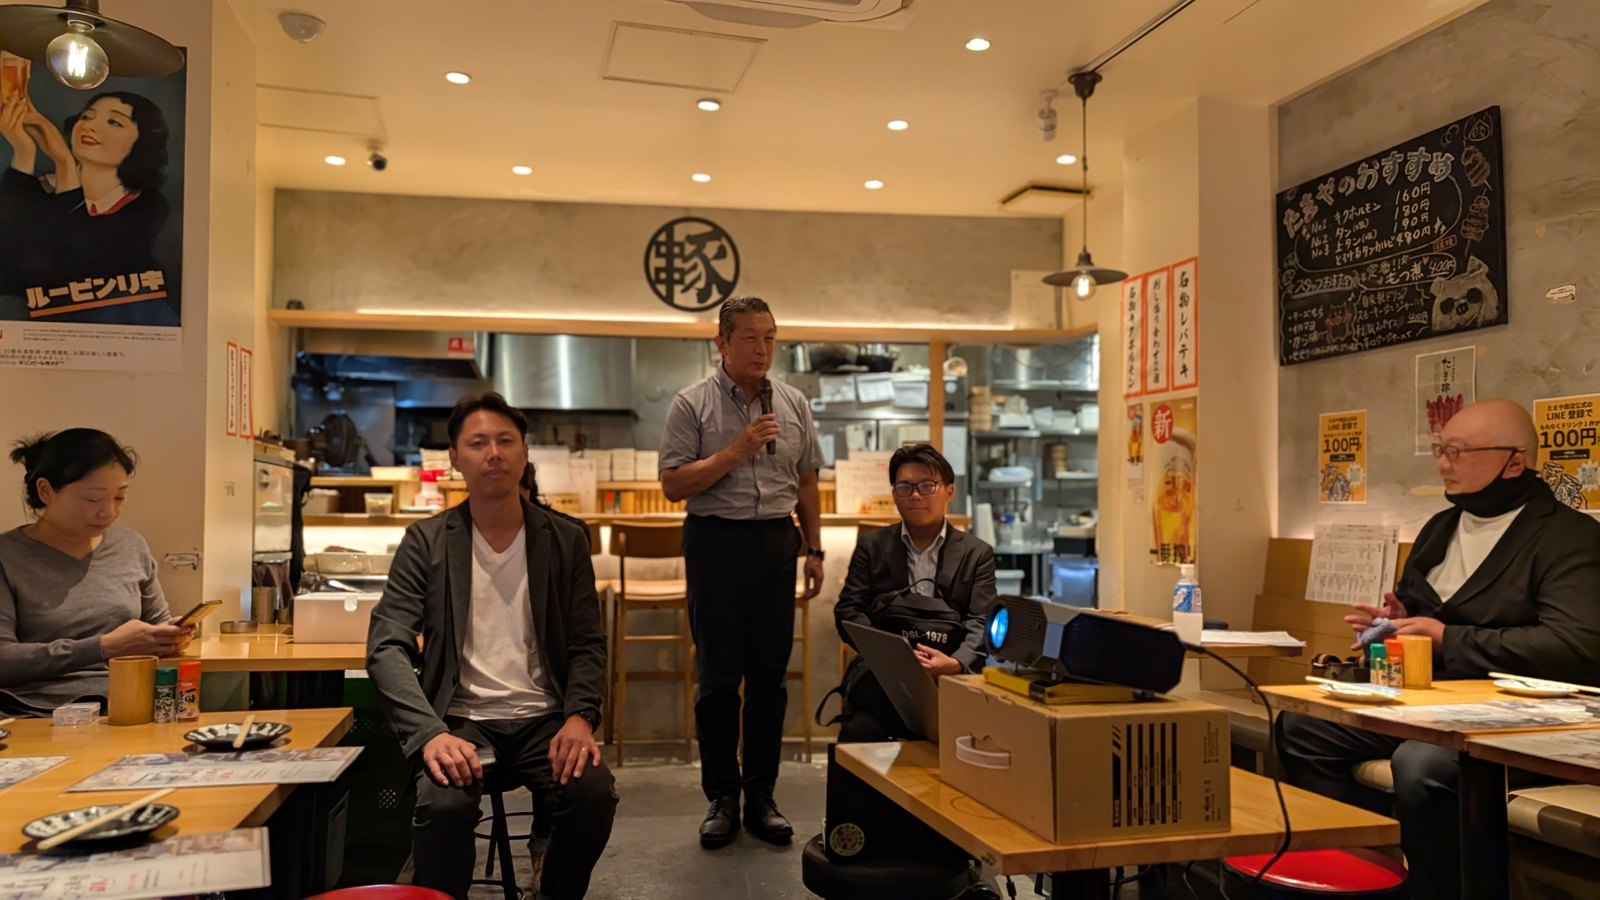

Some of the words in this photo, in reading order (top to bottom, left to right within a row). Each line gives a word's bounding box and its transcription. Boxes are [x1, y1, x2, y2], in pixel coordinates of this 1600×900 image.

[1283, 146, 1455, 239] たまやのおすすめ
[1395, 181, 1431, 205] 160円
[1394, 198, 1430, 220] 180円
[1393, 212, 1430, 233] 190円
[1396, 225, 1431, 246] 480円
[1384, 263, 1424, 285] もつ煮
[1153, 409, 1172, 438] 新
[1546, 411, 1566, 421] LINE
[1568, 409, 1593, 420] 登録で
[902, 629, 948, 644] DSL-1978
